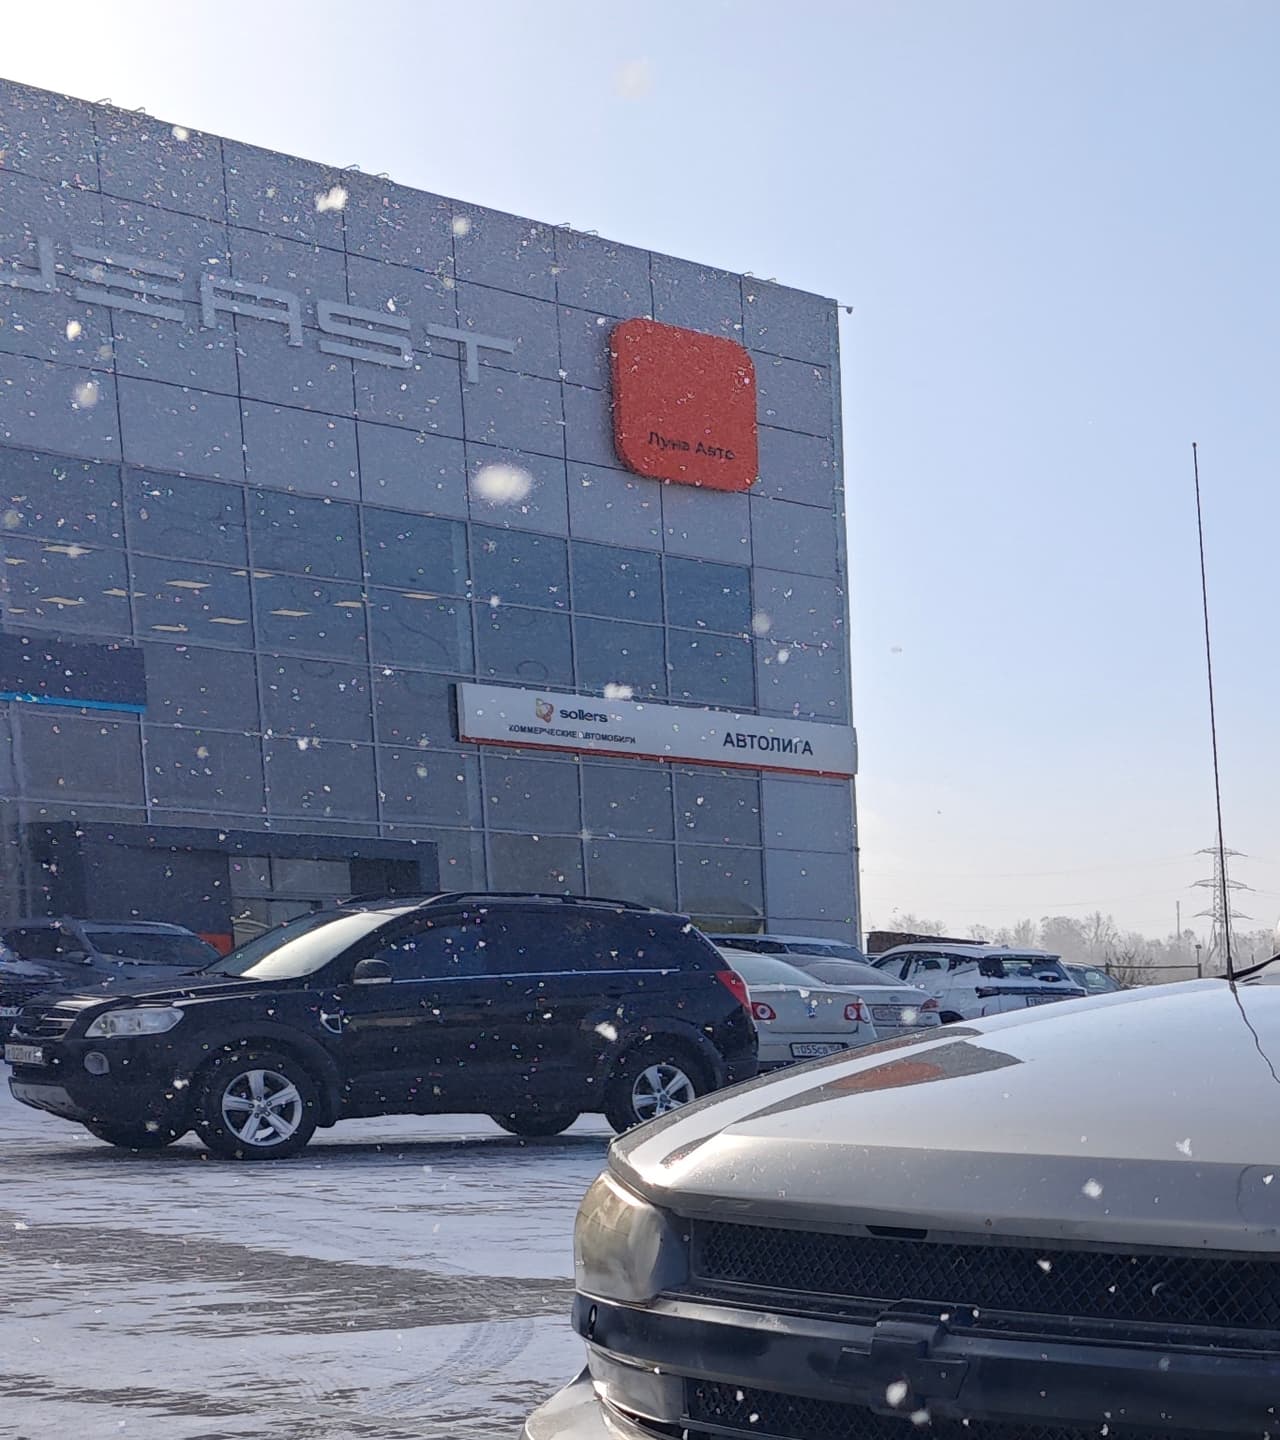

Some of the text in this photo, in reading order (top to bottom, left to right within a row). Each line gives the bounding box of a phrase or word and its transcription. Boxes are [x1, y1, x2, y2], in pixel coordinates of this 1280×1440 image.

[648, 431, 736, 460] Луна Авто
[559, 709, 608, 723] sollers
[723, 731, 813, 756] АВТОЛИГА
